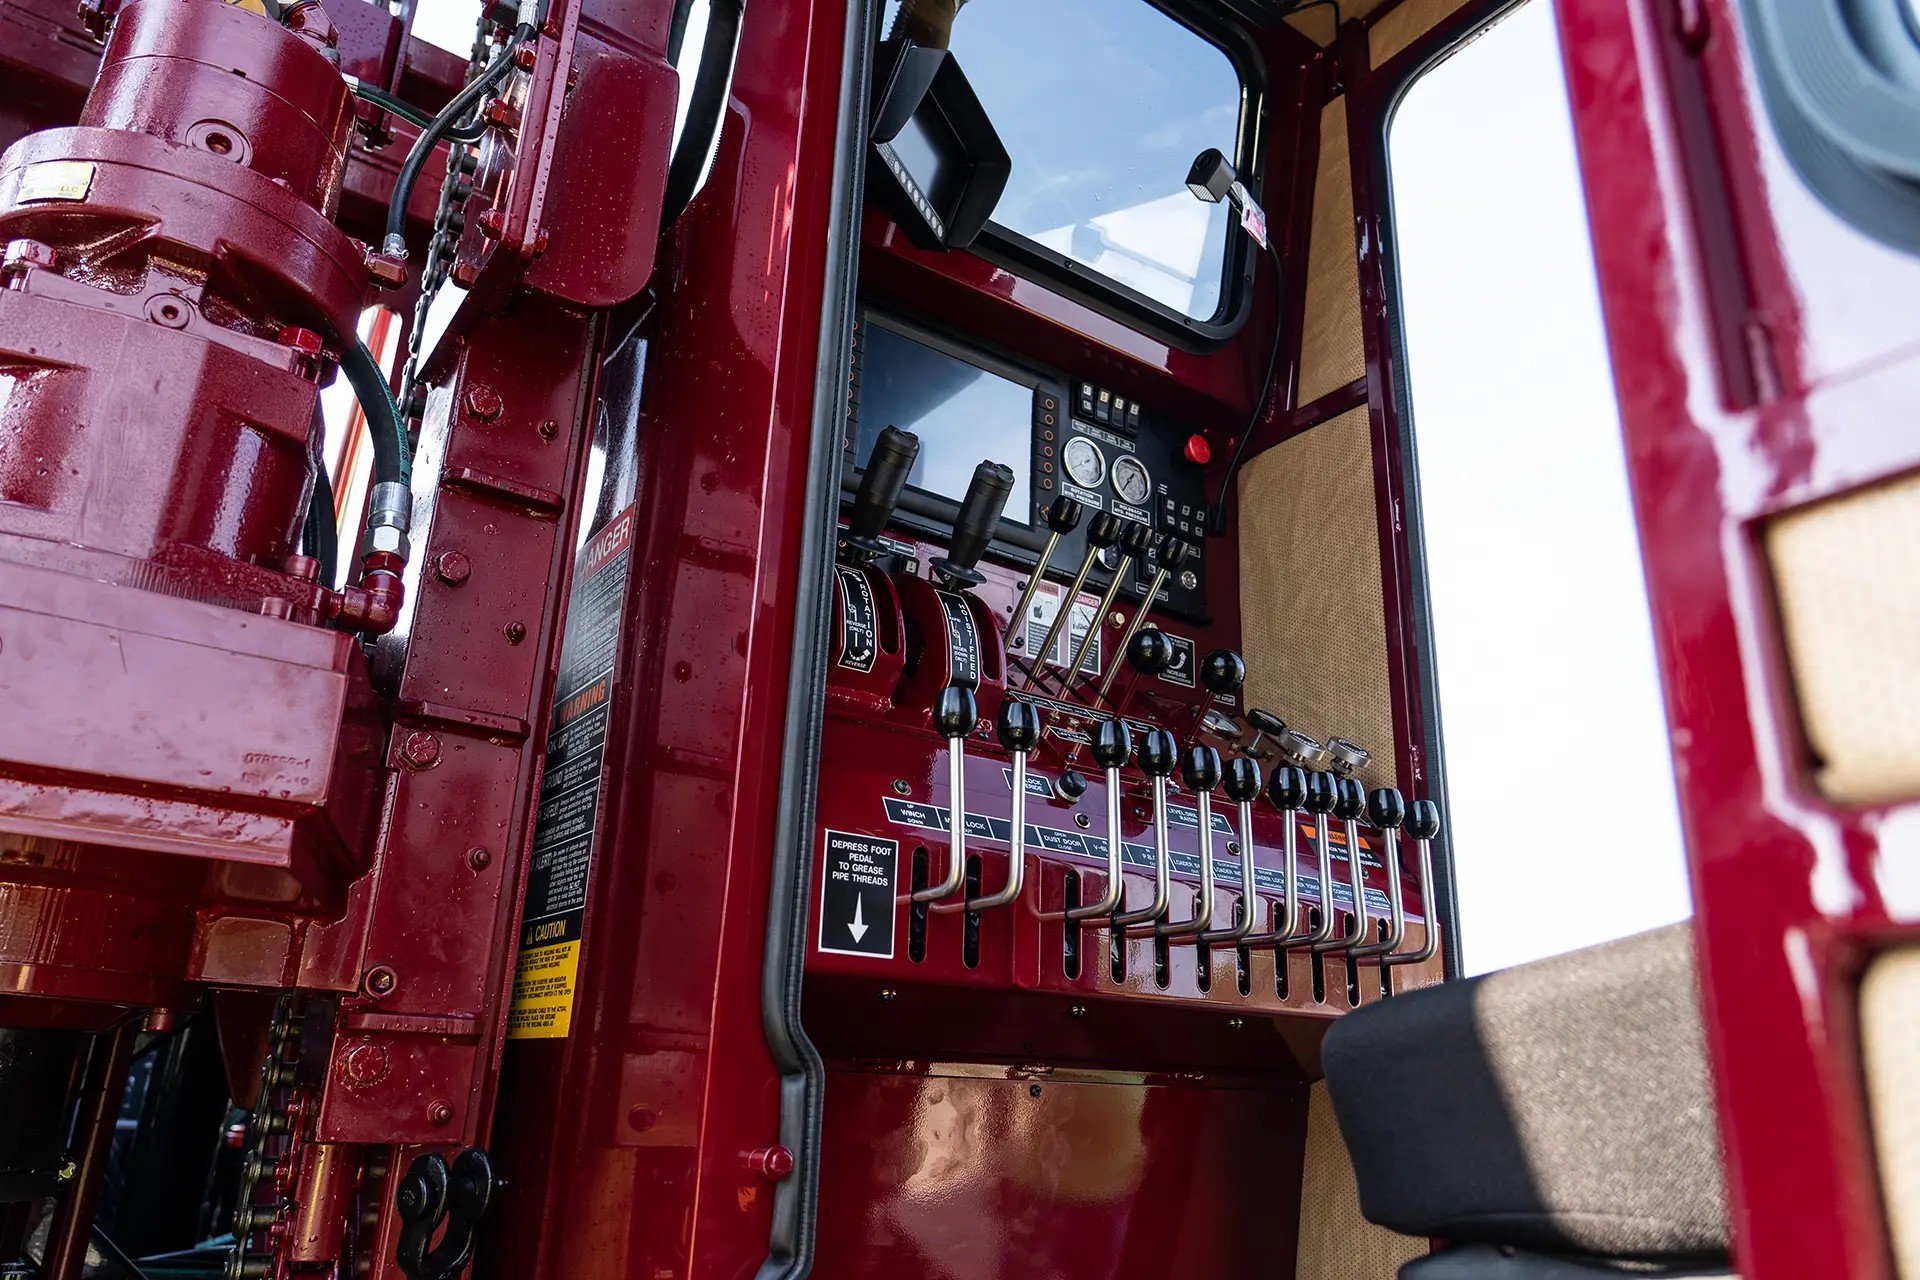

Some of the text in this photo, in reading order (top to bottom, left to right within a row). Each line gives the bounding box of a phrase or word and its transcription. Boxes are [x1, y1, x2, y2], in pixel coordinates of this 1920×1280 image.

[1076, 494, 1100, 506] PRESSURE
[1125, 511, 1148, 522] PRESSURE
[579, 516, 630, 576] DANGER
[860, 583, 872, 647] ROTATION
[1166, 669, 1187, 678] INCREASE
[559, 680, 606, 725] WARNING
[901, 808, 986, 830] WINCH LOCK
[832, 840, 892, 856] DEPRESS FOOT
[1044, 835, 1062, 843] DUST
[1063, 838, 1082, 847] DOOR
[849, 852, 874, 864] PEDAL
[838, 861, 883, 875] TO GREASE
[1213, 867, 1234, 875] LOADER
[832, 871, 888, 886] PIPE THREADS
[535, 920, 566, 942] CAUTION
